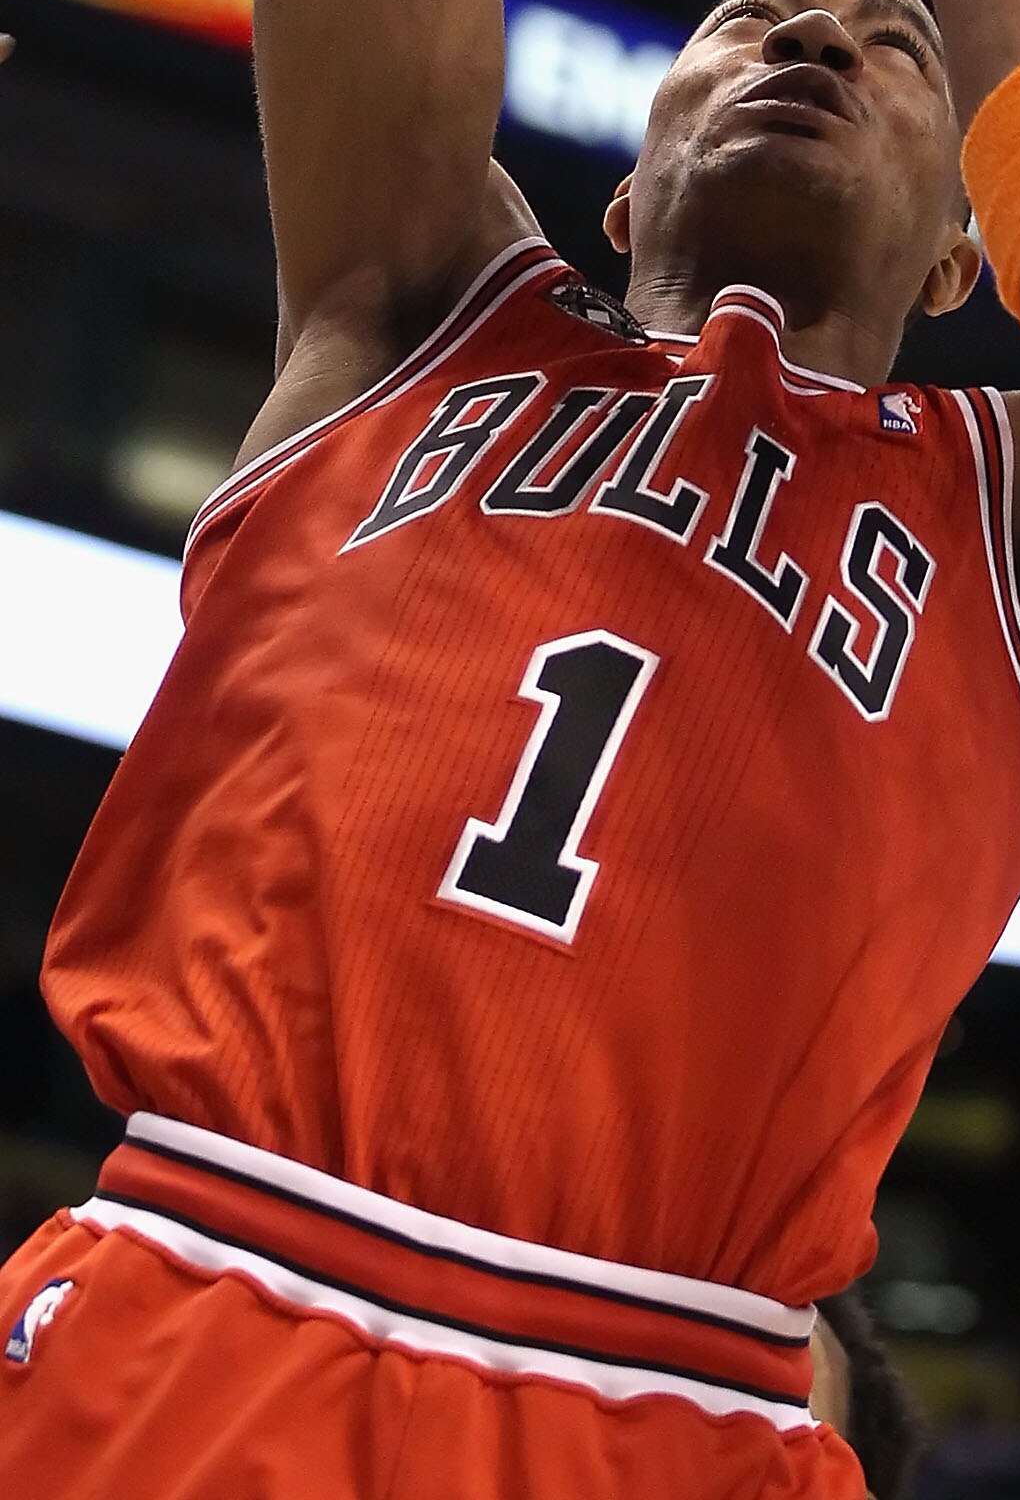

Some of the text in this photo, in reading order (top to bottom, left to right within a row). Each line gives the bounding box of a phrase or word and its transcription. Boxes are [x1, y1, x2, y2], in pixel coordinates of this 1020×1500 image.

[338, 370, 937, 722] BULLS
[882, 419, 911, 431] NBA
[435, 628, 661, 946] 1
